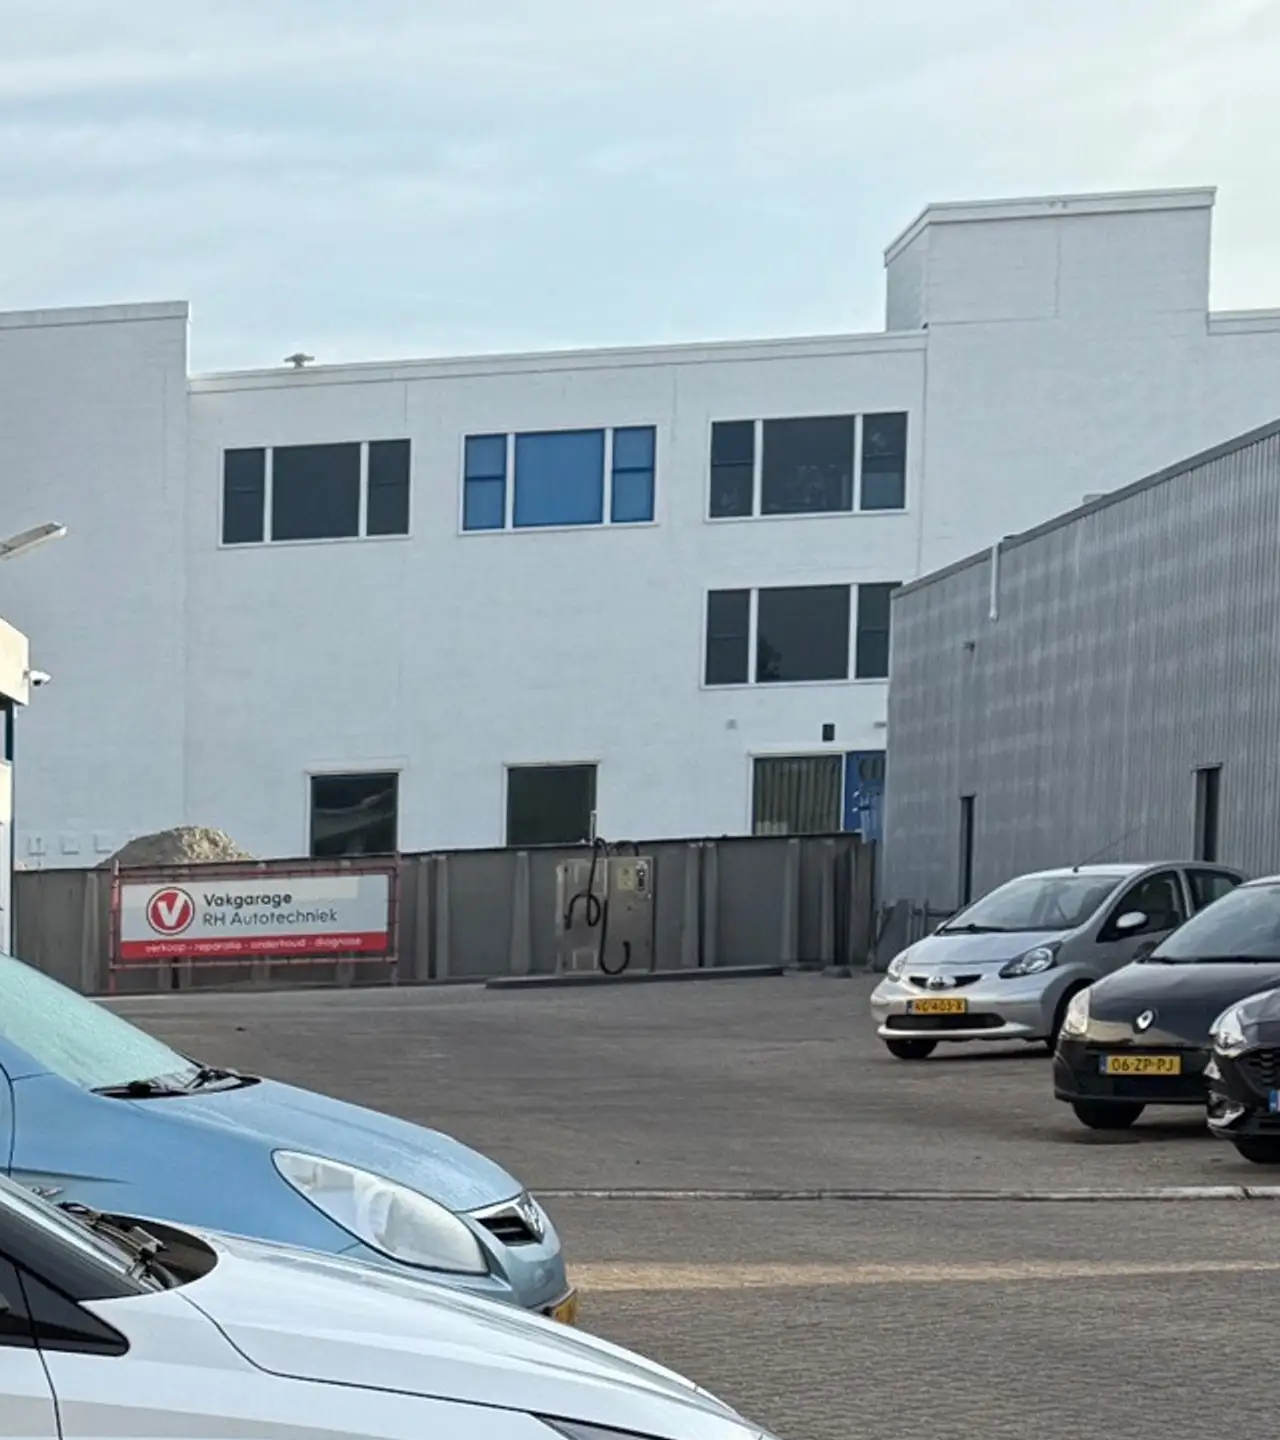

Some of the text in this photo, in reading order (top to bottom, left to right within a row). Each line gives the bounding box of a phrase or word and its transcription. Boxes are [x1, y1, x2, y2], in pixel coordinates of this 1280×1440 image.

[203, 893, 293, 909] Vakgarage
[203, 908, 338, 927] RH Autotechniek
[1111, 1058, 1174, 1072] 06-ZP-PJ
